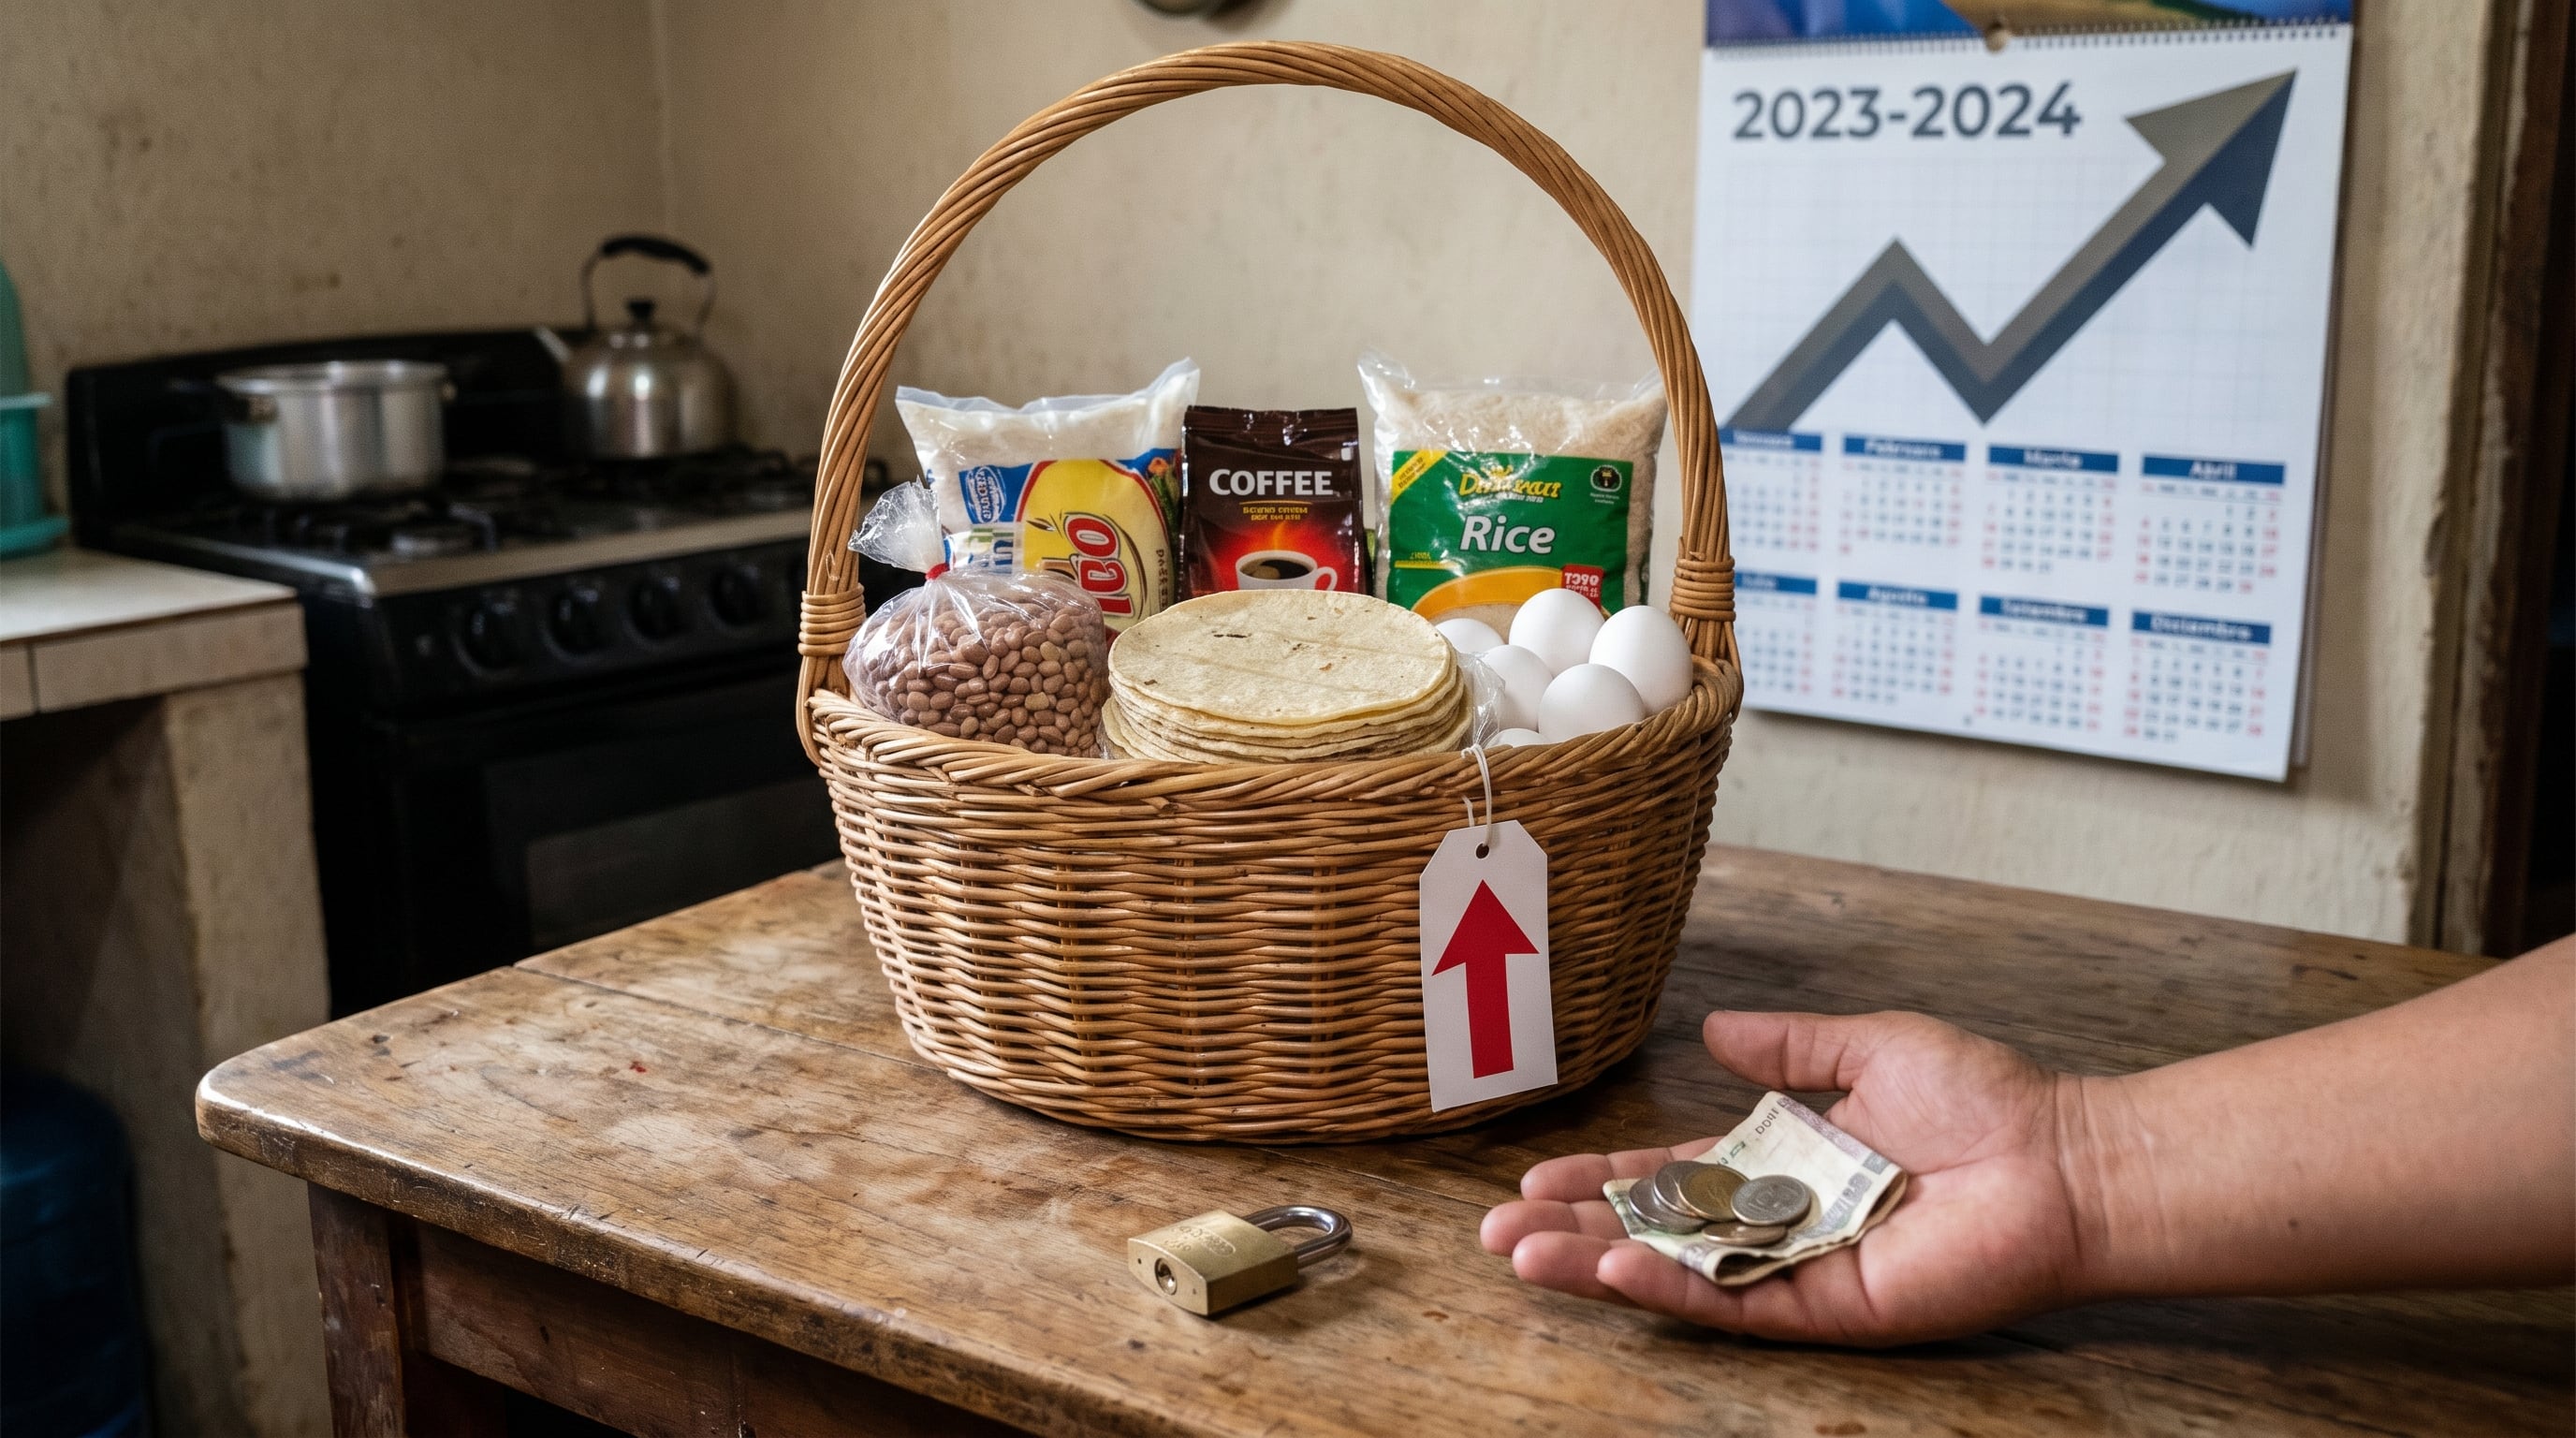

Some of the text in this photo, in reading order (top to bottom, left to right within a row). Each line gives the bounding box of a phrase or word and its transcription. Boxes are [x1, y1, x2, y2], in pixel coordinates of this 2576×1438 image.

[1734, 81, 2081, 140] 2023-2024
[1209, 469, 1333, 495] COFFEE
[1460, 516, 1556, 554] Rice
